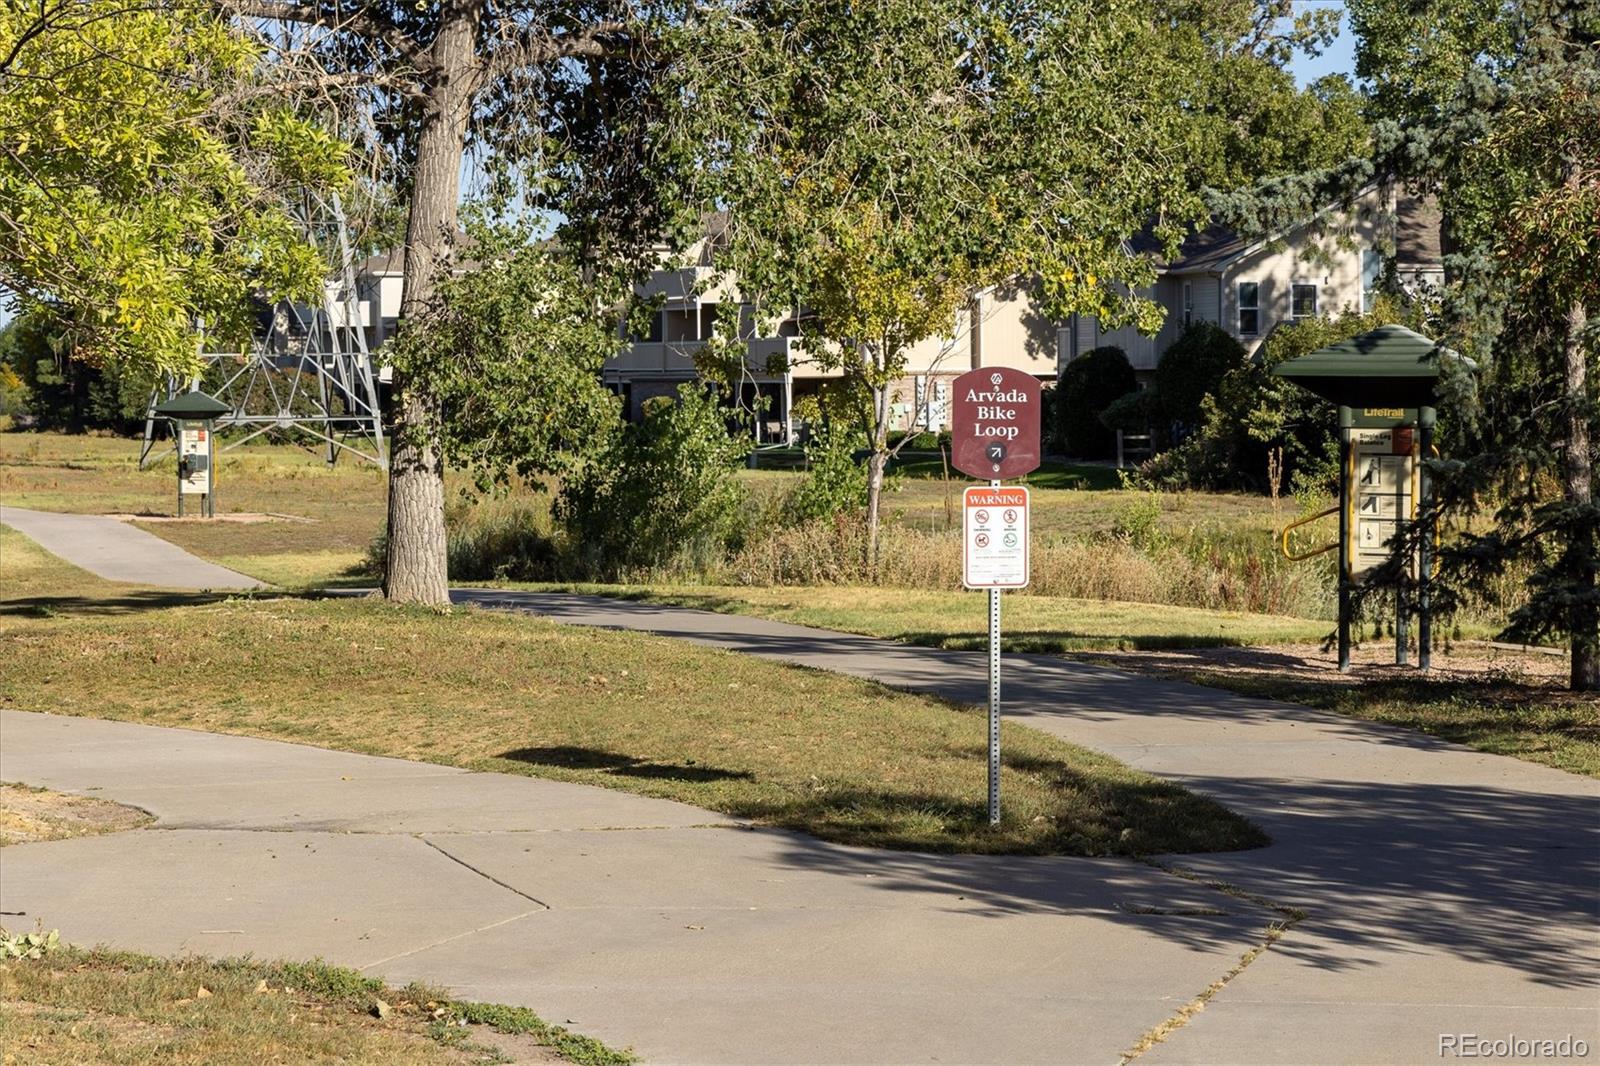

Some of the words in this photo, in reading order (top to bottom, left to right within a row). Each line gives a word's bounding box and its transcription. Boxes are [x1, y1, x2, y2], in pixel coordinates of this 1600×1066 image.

[965, 389, 1028, 402] Arvada
[977, 406, 1016, 420] Bike
[974, 423, 1019, 440] Loop
[1359, 432, 1379, 441] Single
[969, 495, 1023, 505] WARNING
